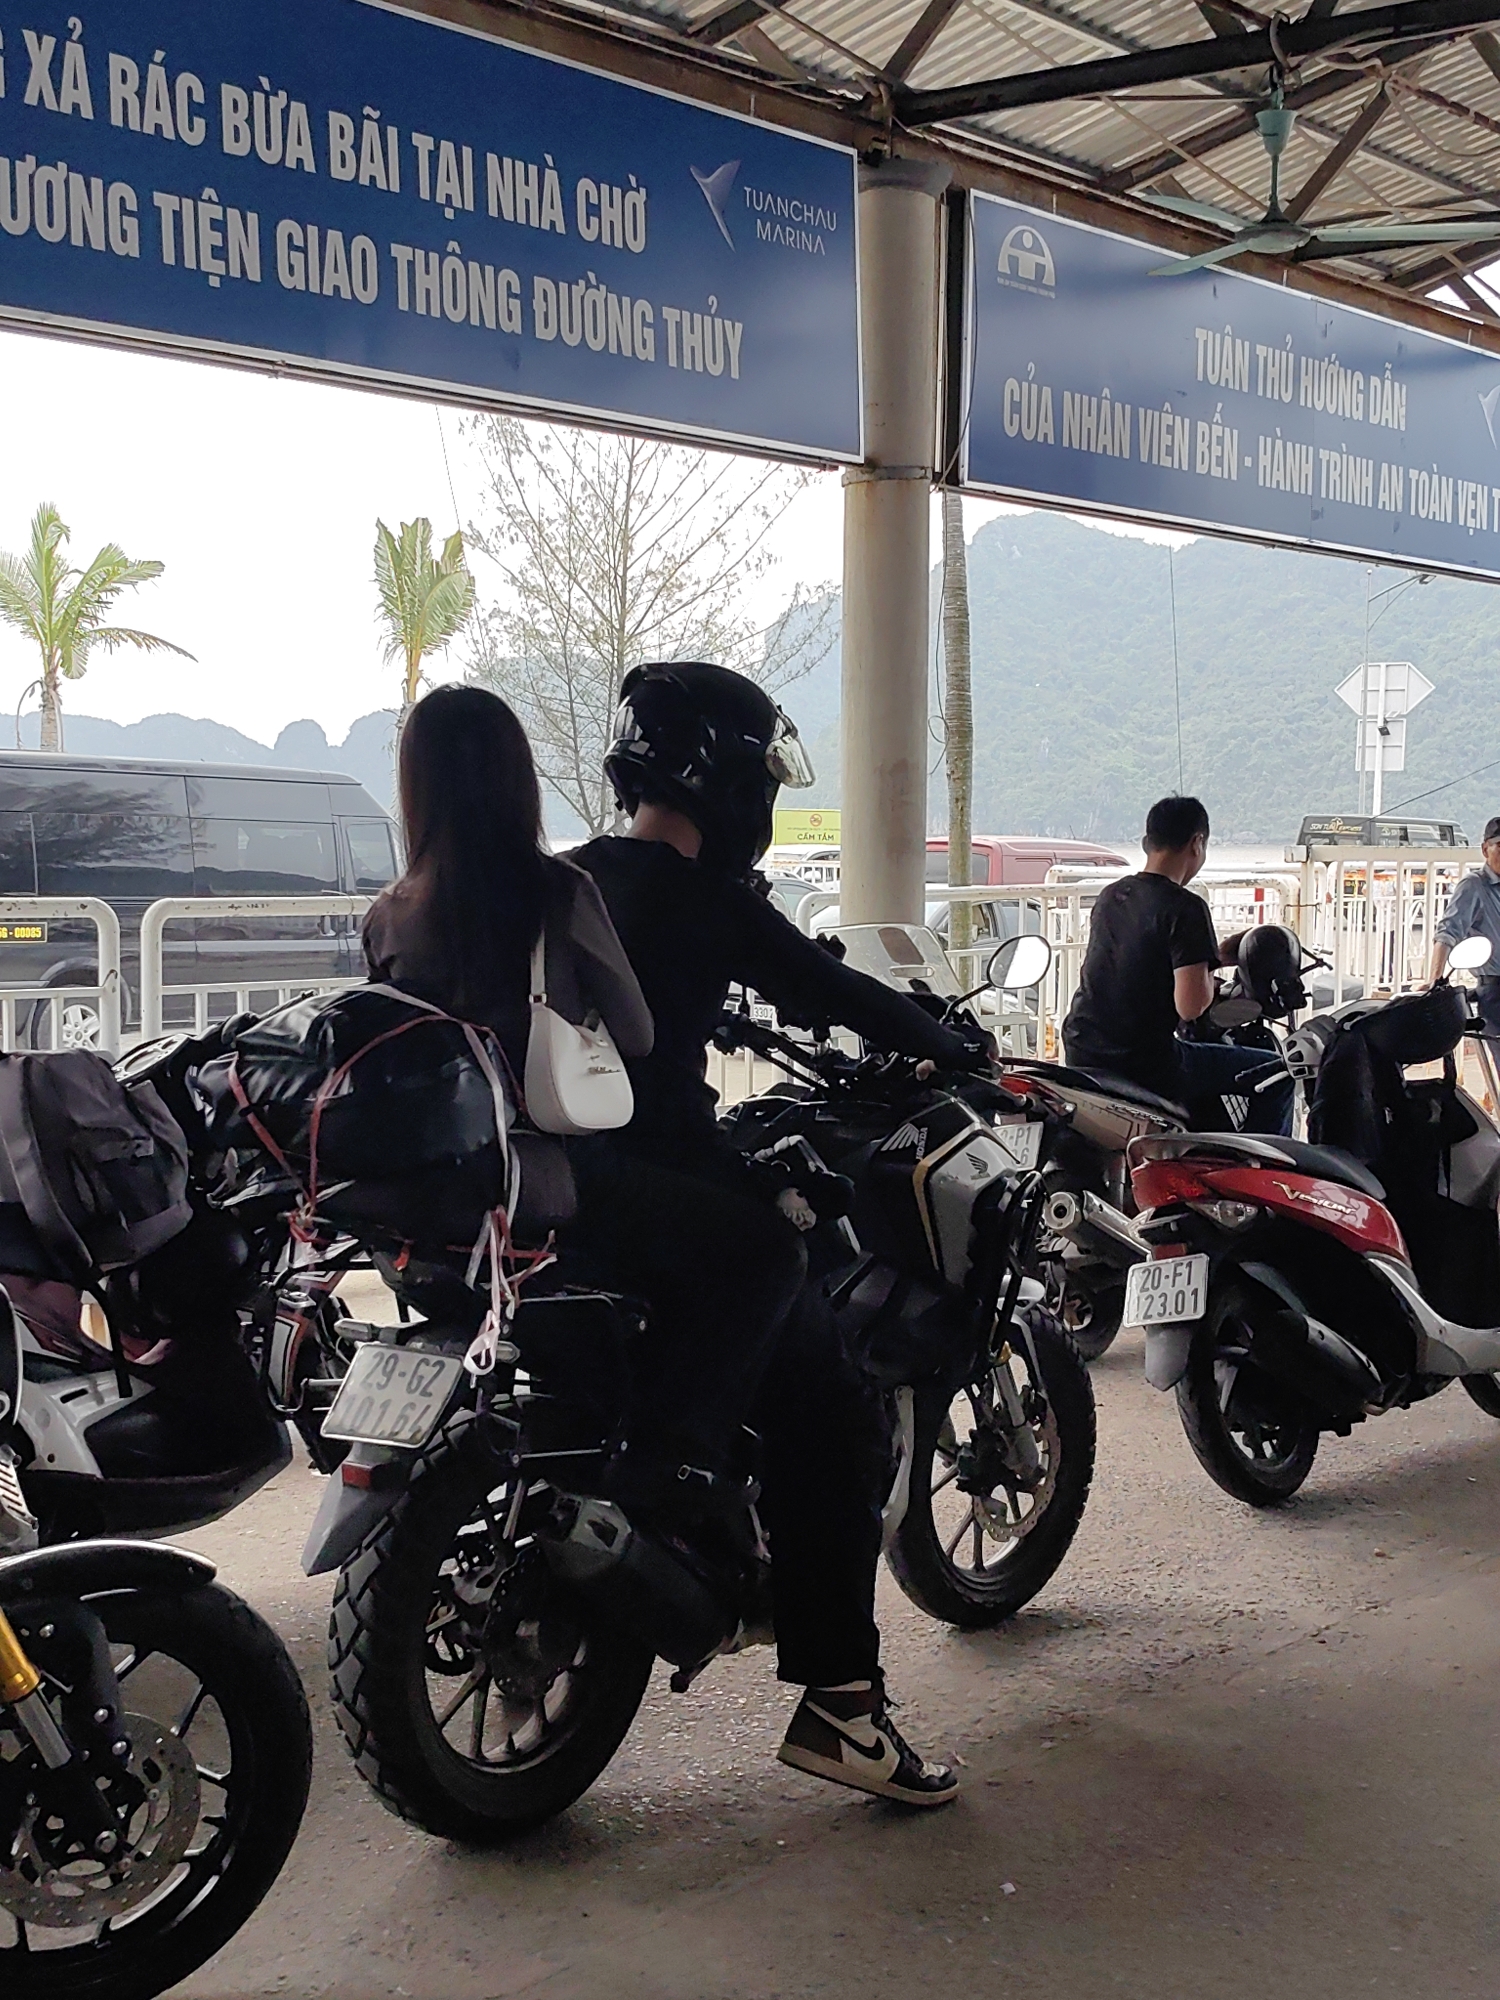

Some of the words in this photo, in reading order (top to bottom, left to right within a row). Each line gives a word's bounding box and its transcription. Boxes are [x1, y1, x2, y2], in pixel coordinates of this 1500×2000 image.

[22, 16, 94, 120] XẢ
[109, 49, 206, 146] RÁC
[221, 75, 316, 173] BỪA
[328, 105, 400, 194] BÃI
[411, 131, 474, 220] TẠI
[486, 152, 566, 235] NHÀ
[576, 173, 648, 254] CHỜ
[744, 186, 837, 231] TUANCHAU
[757, 219, 826, 256] MARINA
[153, 187, 262, 288] TIỆN
[276, 219, 379, 305] GIAO
[391, 240, 522, 335] THÔNG
[533, 271, 655, 362] ĐƯỜNG
[662, 295, 743, 380] THỦY
[1195, 325, 1250, 394] TUÂN
[1256, 334, 1295, 404] THỦ
[1300, 348, 1364, 421] HƯỚNG
[1369, 361, 1407, 431] DẪN
[1004, 361, 1055, 445] CỦA
[1062, 388, 1131, 460] NHÂN
[1139, 402, 1189, 472] VIÊN
[1197, 402, 1238, 481] BẾN
[1258, 427, 1314, 496] HÀNH
[1319, 443, 1373, 508] TRÌNH
[1378, 462, 1403, 512] AN
[1409, 463, 1453, 523] TOÀN
[1458, 479, 1488, 536] VẸN
[916, 1127, 928, 1159] HONDA
[1139, 1261, 1193, 1293] 20-F1
[360, 1351, 446, 1398] 29-G2
